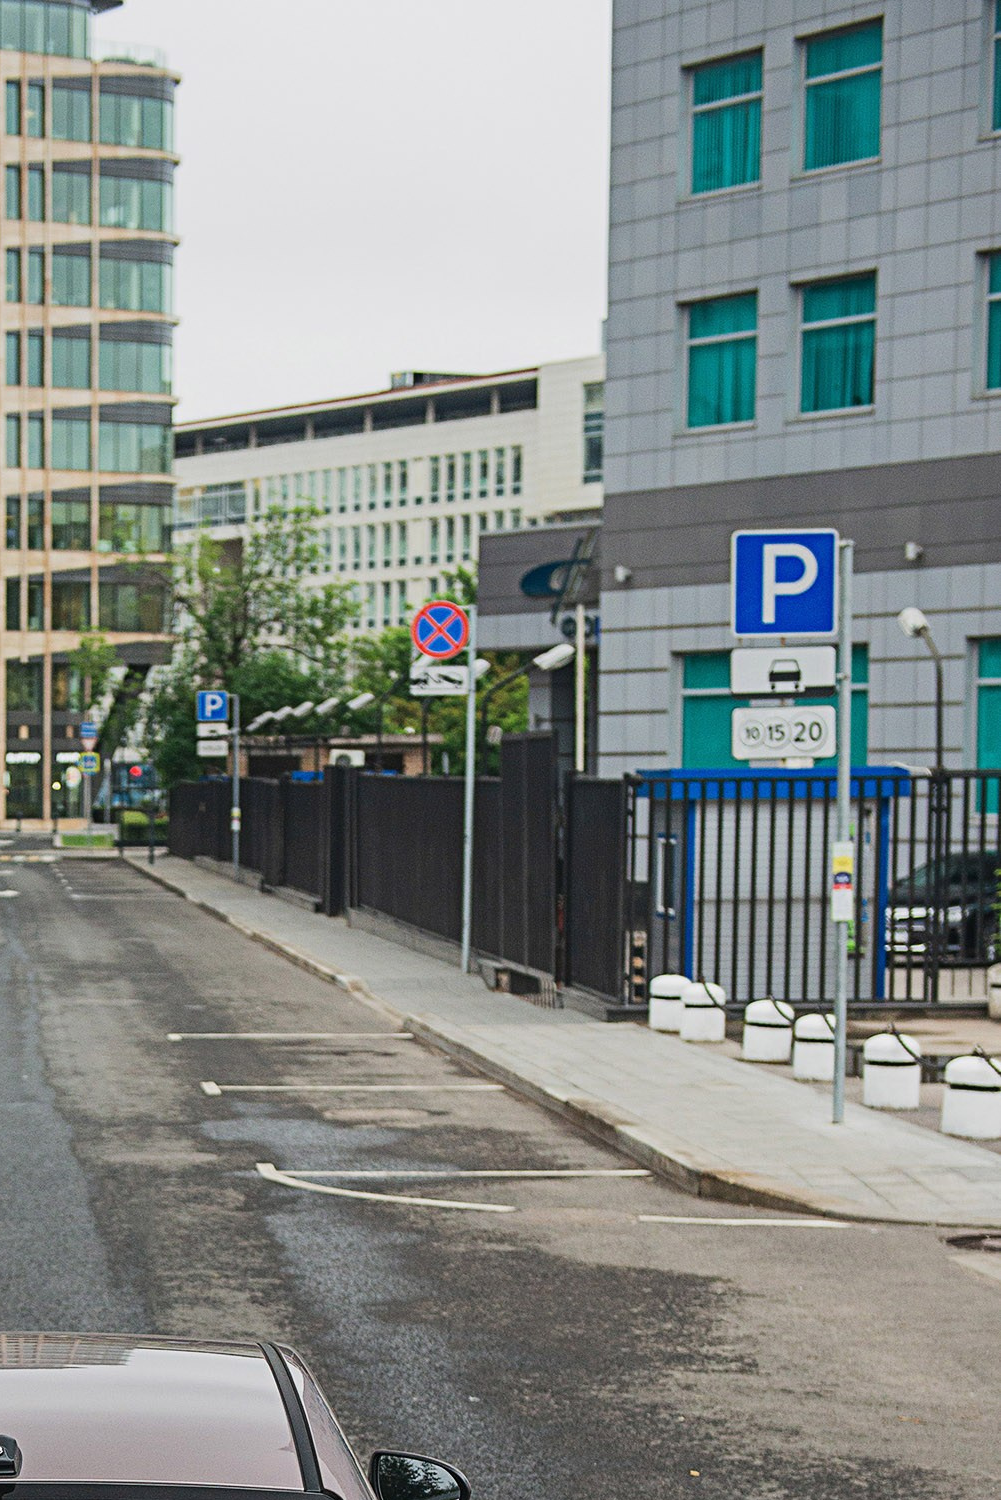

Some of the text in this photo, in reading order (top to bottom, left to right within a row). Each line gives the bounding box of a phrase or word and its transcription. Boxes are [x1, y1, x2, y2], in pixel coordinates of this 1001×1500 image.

[761, 543, 819, 625] P
[205, 693, 224, 718] P
[745, 721, 823, 742] 10 15 20
